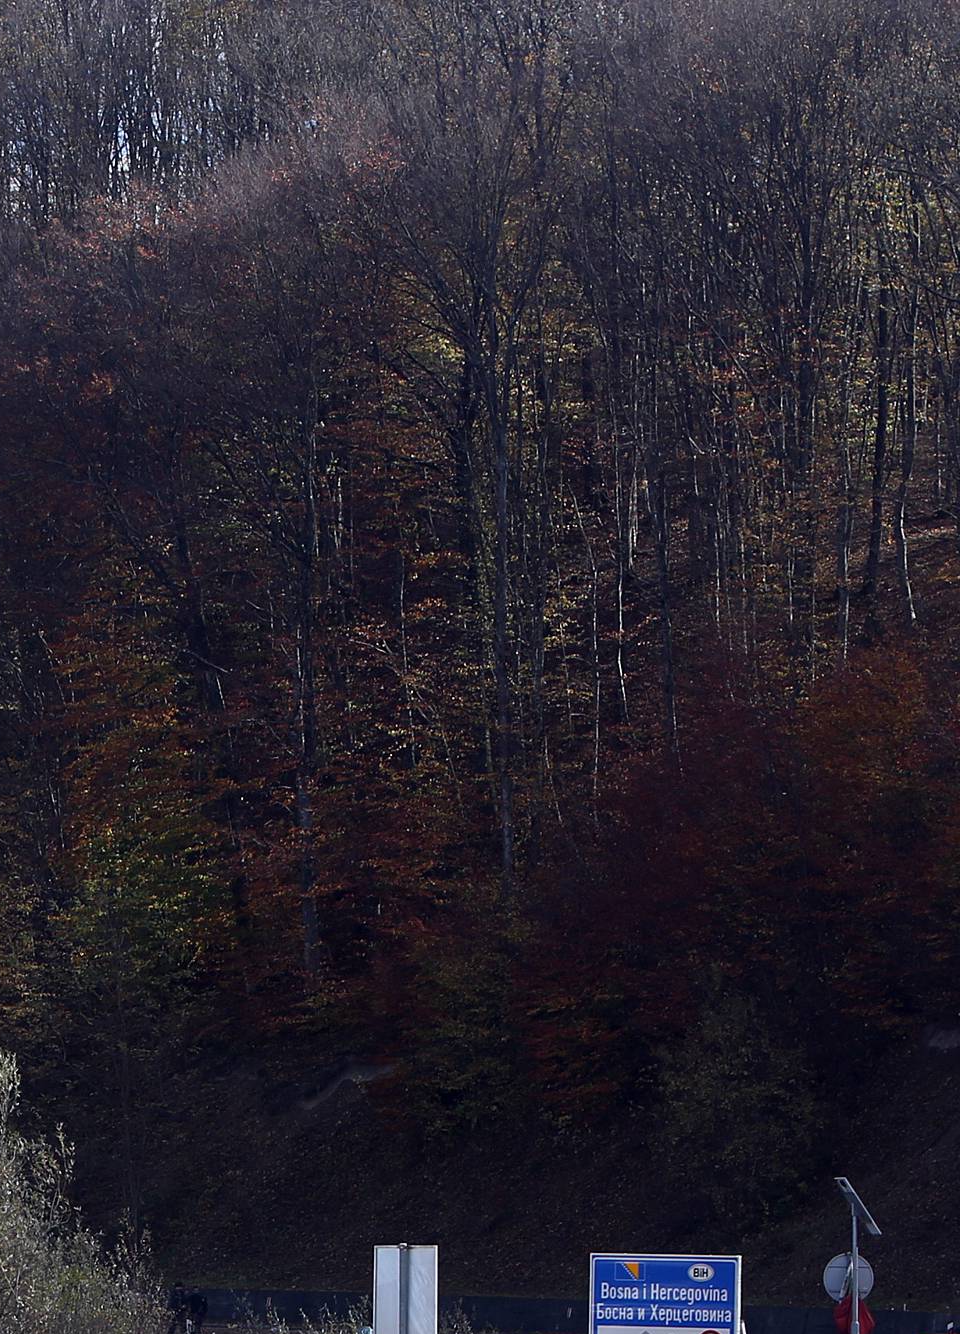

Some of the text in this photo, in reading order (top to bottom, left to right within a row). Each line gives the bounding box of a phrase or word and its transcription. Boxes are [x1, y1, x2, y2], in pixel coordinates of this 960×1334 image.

[693, 1267, 709, 1278] BiH
[601, 1282, 728, 1305] Bosna i Hercegovina
[596, 1303, 732, 1325] Босна и Херцеговина
